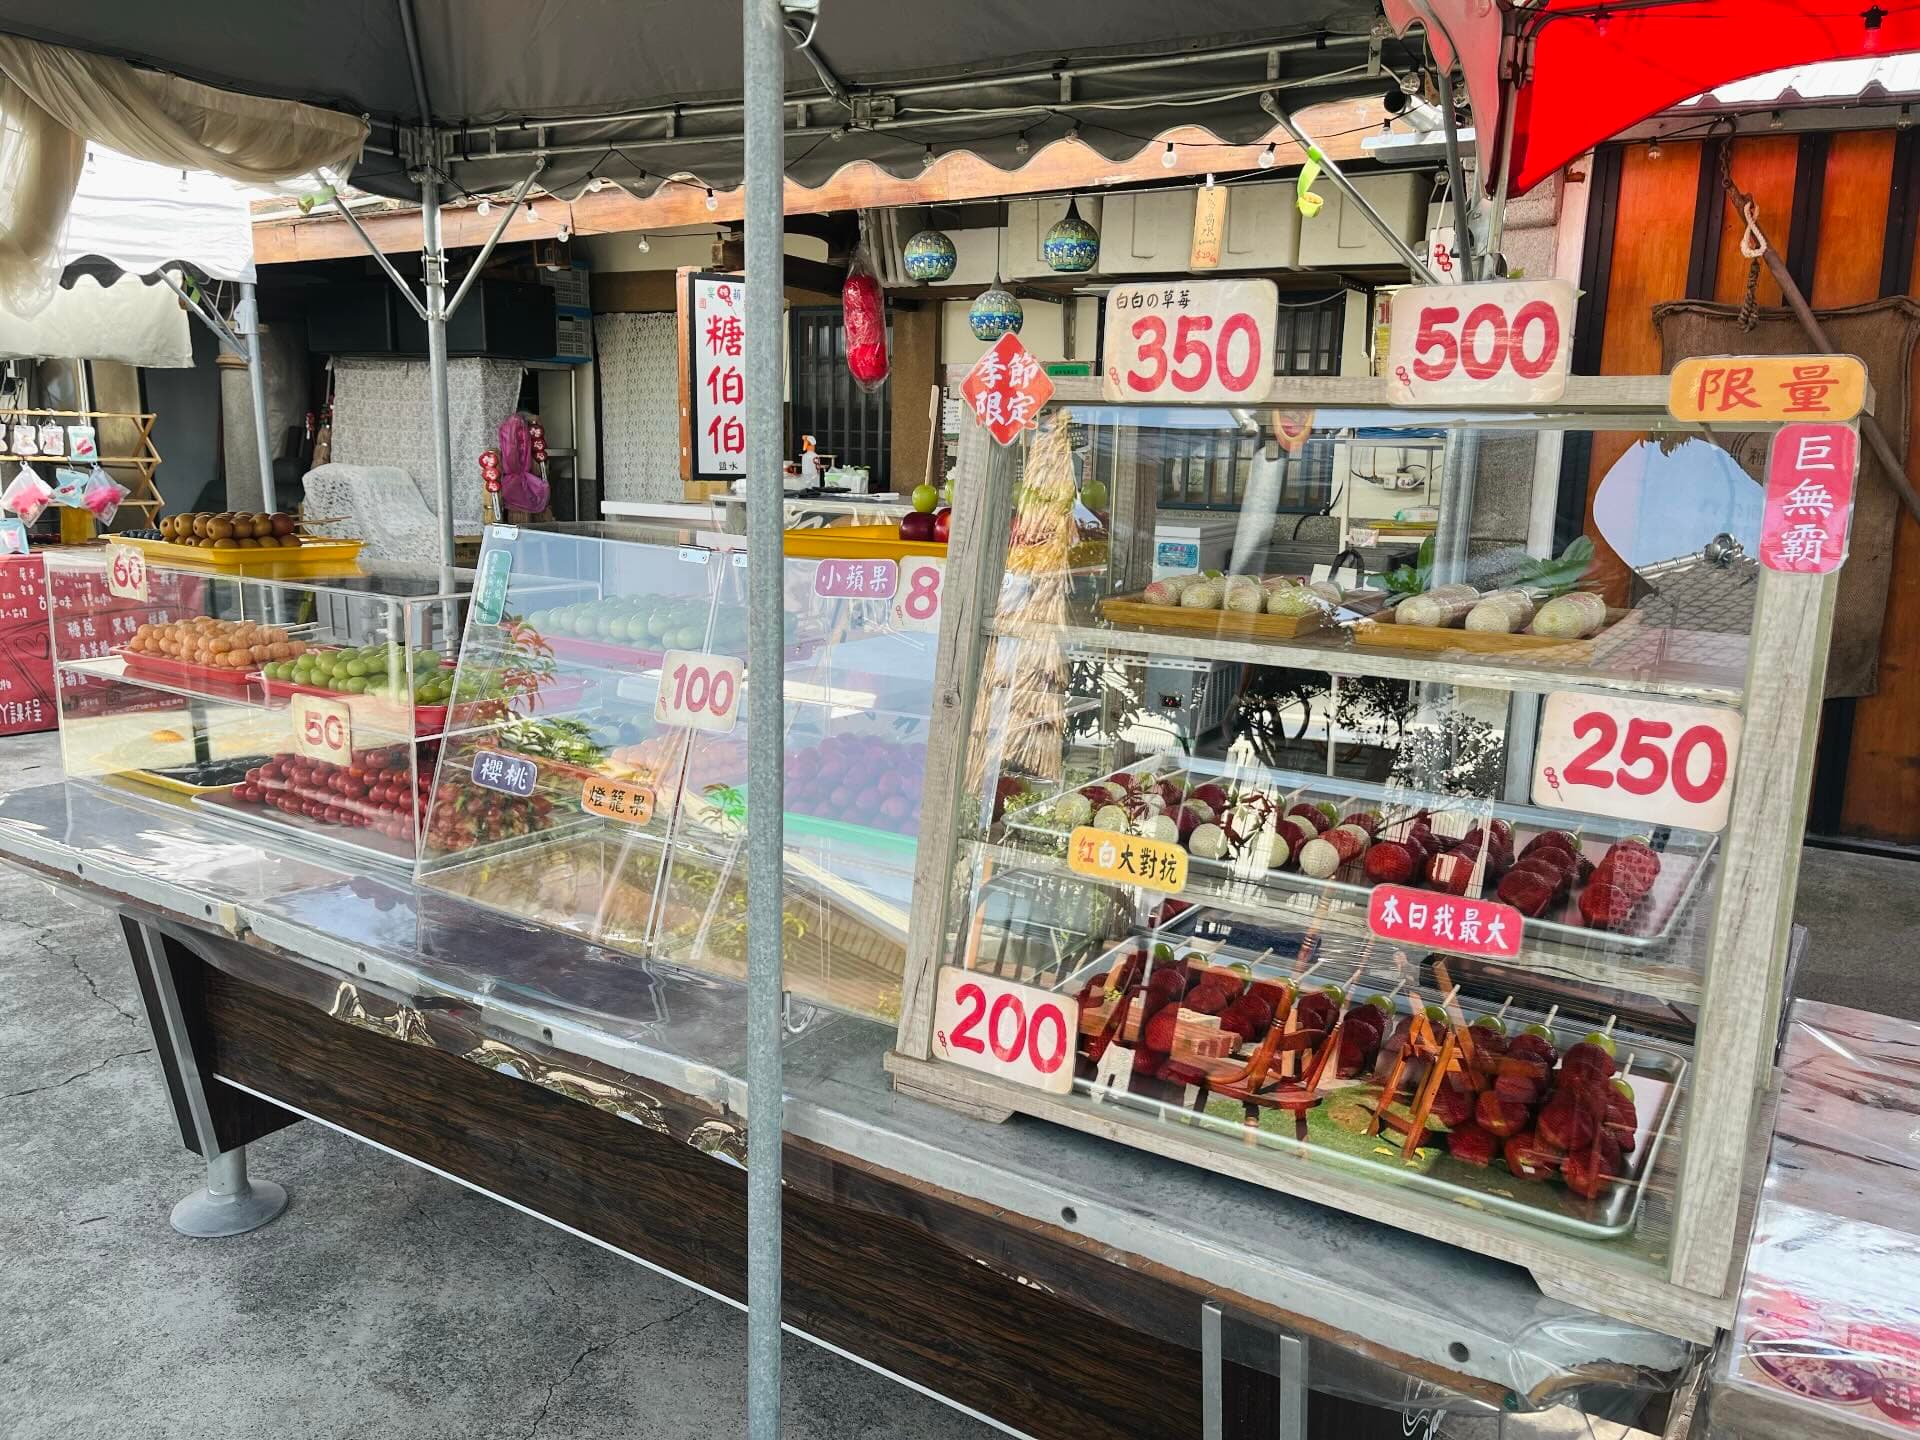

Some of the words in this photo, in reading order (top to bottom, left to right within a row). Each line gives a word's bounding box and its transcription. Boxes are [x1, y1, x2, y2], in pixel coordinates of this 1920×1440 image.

[1115, 289, 1191, 310] 白白の草莓
[1127, 313, 1260, 393] 350
[1413, 301, 1560, 381] 500
[706, 314, 744, 455] 糖伯伯
[976, 351, 1039, 389] 季節
[1697, 364, 1840, 414] 限量
[975, 390, 1036, 427] 限定
[1781, 434, 1836, 566] 巨無霸
[113, 553, 143, 589] 60
[822, 564, 888, 591] 小蘋果
[905, 566, 943, 620] 8
[673, 664, 735, 718] 100
[304, 710, 344, 751] 50
[480, 757, 528, 790] 櫻桃
[1563, 711, 1727, 803] 250
[589, 784, 646, 817] 燈籠果
[1077, 836, 1178, 885] 紅白大對抗
[1380, 894, 1508, 949] 本日我最大
[949, 982, 1068, 1074] 200
